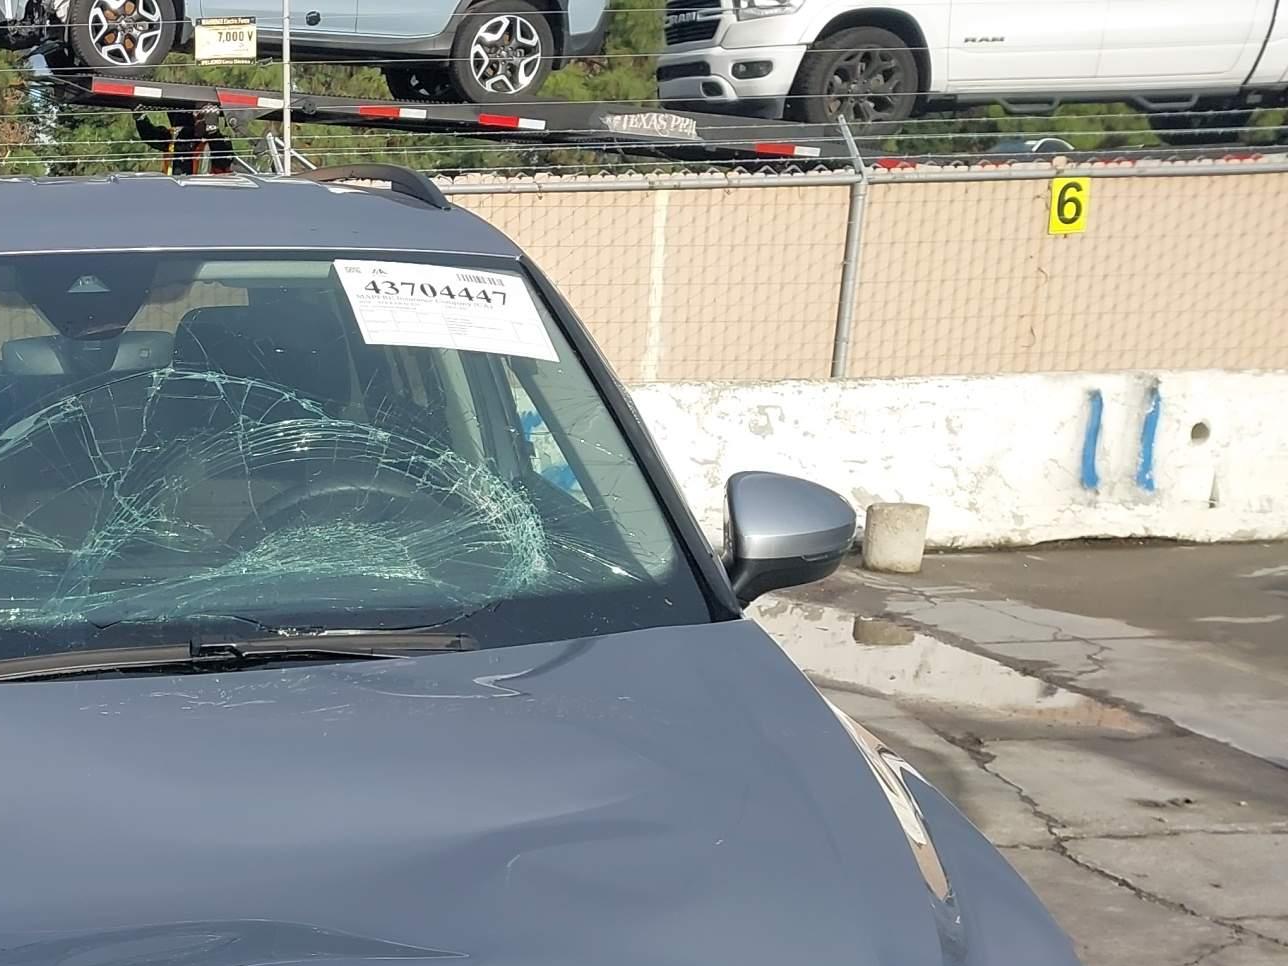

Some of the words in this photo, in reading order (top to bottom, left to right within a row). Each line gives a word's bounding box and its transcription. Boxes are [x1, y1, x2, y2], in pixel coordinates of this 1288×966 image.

[217, 31, 244, 43] 7,000
[247, 31, 253, 41] V
[1057, 182, 1082, 224] 6
[364, 279, 507, 306] 43704447
